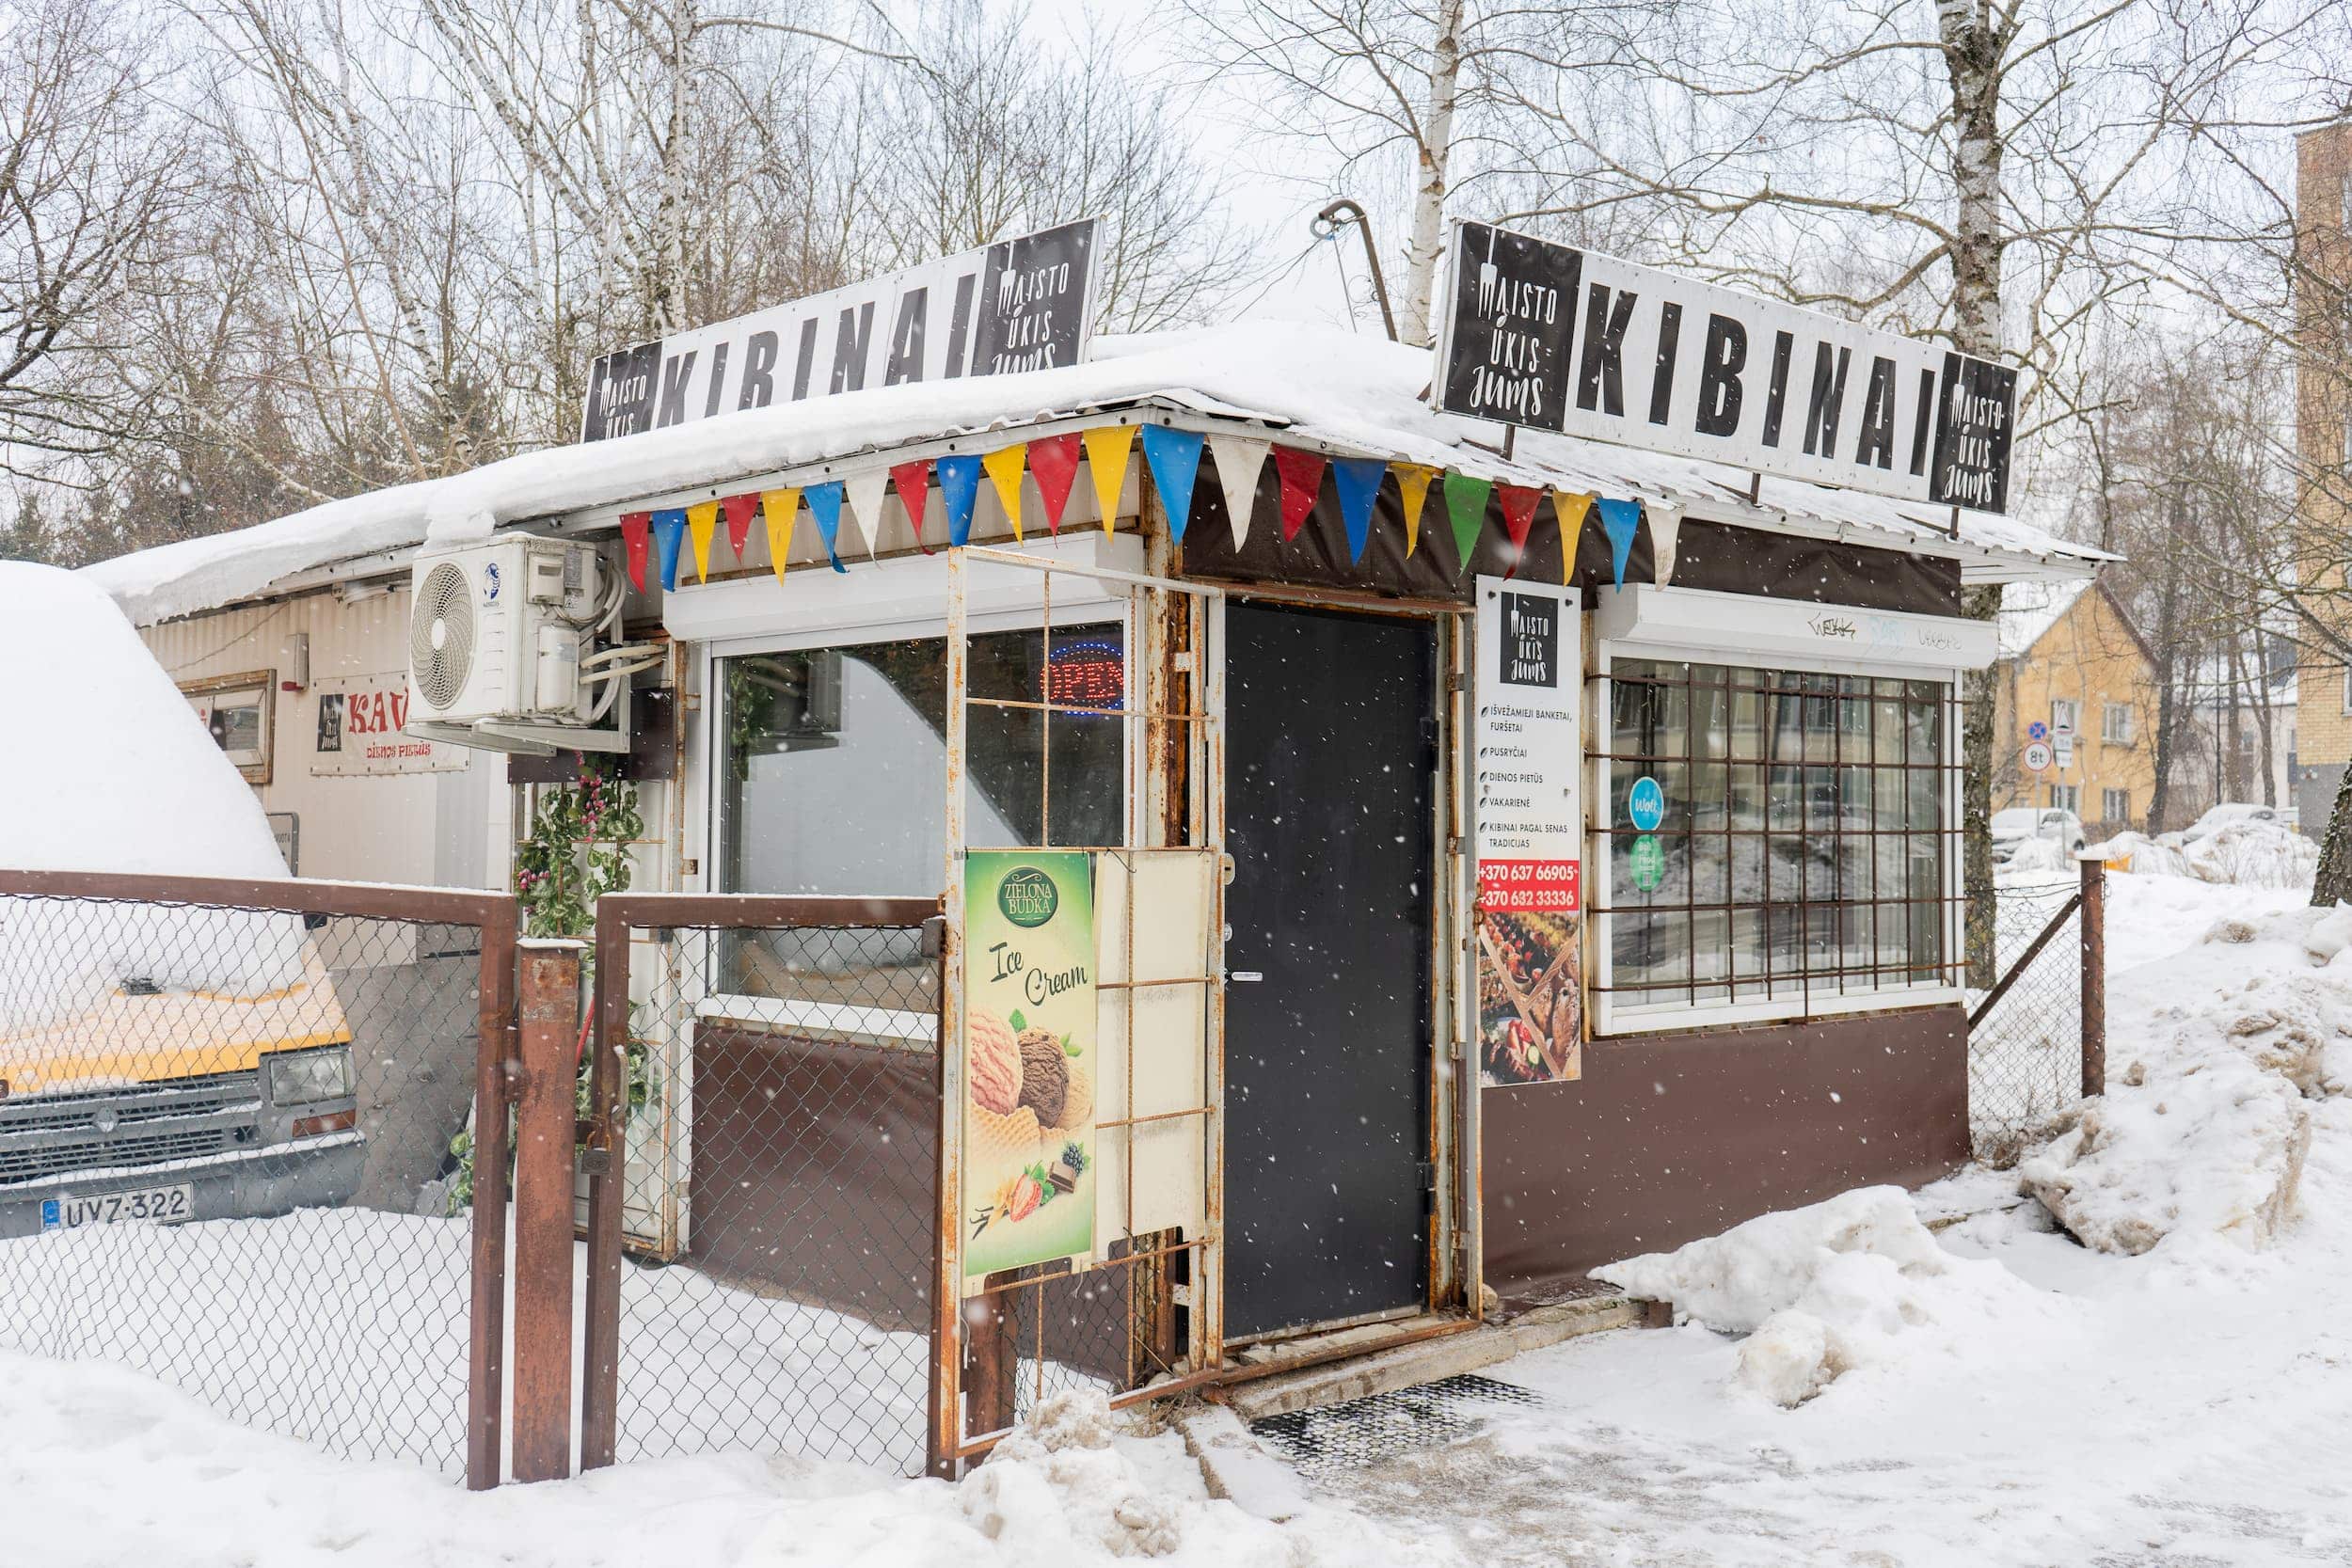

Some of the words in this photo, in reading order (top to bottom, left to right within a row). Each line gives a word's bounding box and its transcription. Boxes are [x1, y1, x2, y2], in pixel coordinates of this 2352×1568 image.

[997, 262, 1070, 317] MAISTO
[1478, 262, 1557, 325] MAISTO
[656, 273, 976, 429] KIBINAI
[599, 374, 647, 417] MAISTO
[1576, 282, 1935, 476] KIBINAI
[1951, 384, 2003, 430] MAISTO
[1510, 610, 1549, 638] MAISTO
[1040, 661, 1123, 699] OPEN
[348, 686, 409, 734] KAV
[1489, 772, 1518, 783] DIENOS
[1489, 822, 1518, 833] KIBINAI
[1519, 823, 1543, 833] PAGAL
[1545, 824, 1568, 834] SENAS
[1489, 838, 1531, 848] TRADICIJAS
[1004, 883, 1053, 900] ZIELONA
[1480, 864, 1508, 881] +370
[1511, 865, 1534, 881] 637
[1535, 865, 1574, 881] 66905
[1009, 897, 1052, 914] BUDKA
[1535, 890, 1574, 906] 33336
[989, 942, 1024, 983] Ice
[1025, 966, 1089, 1006] Cream
